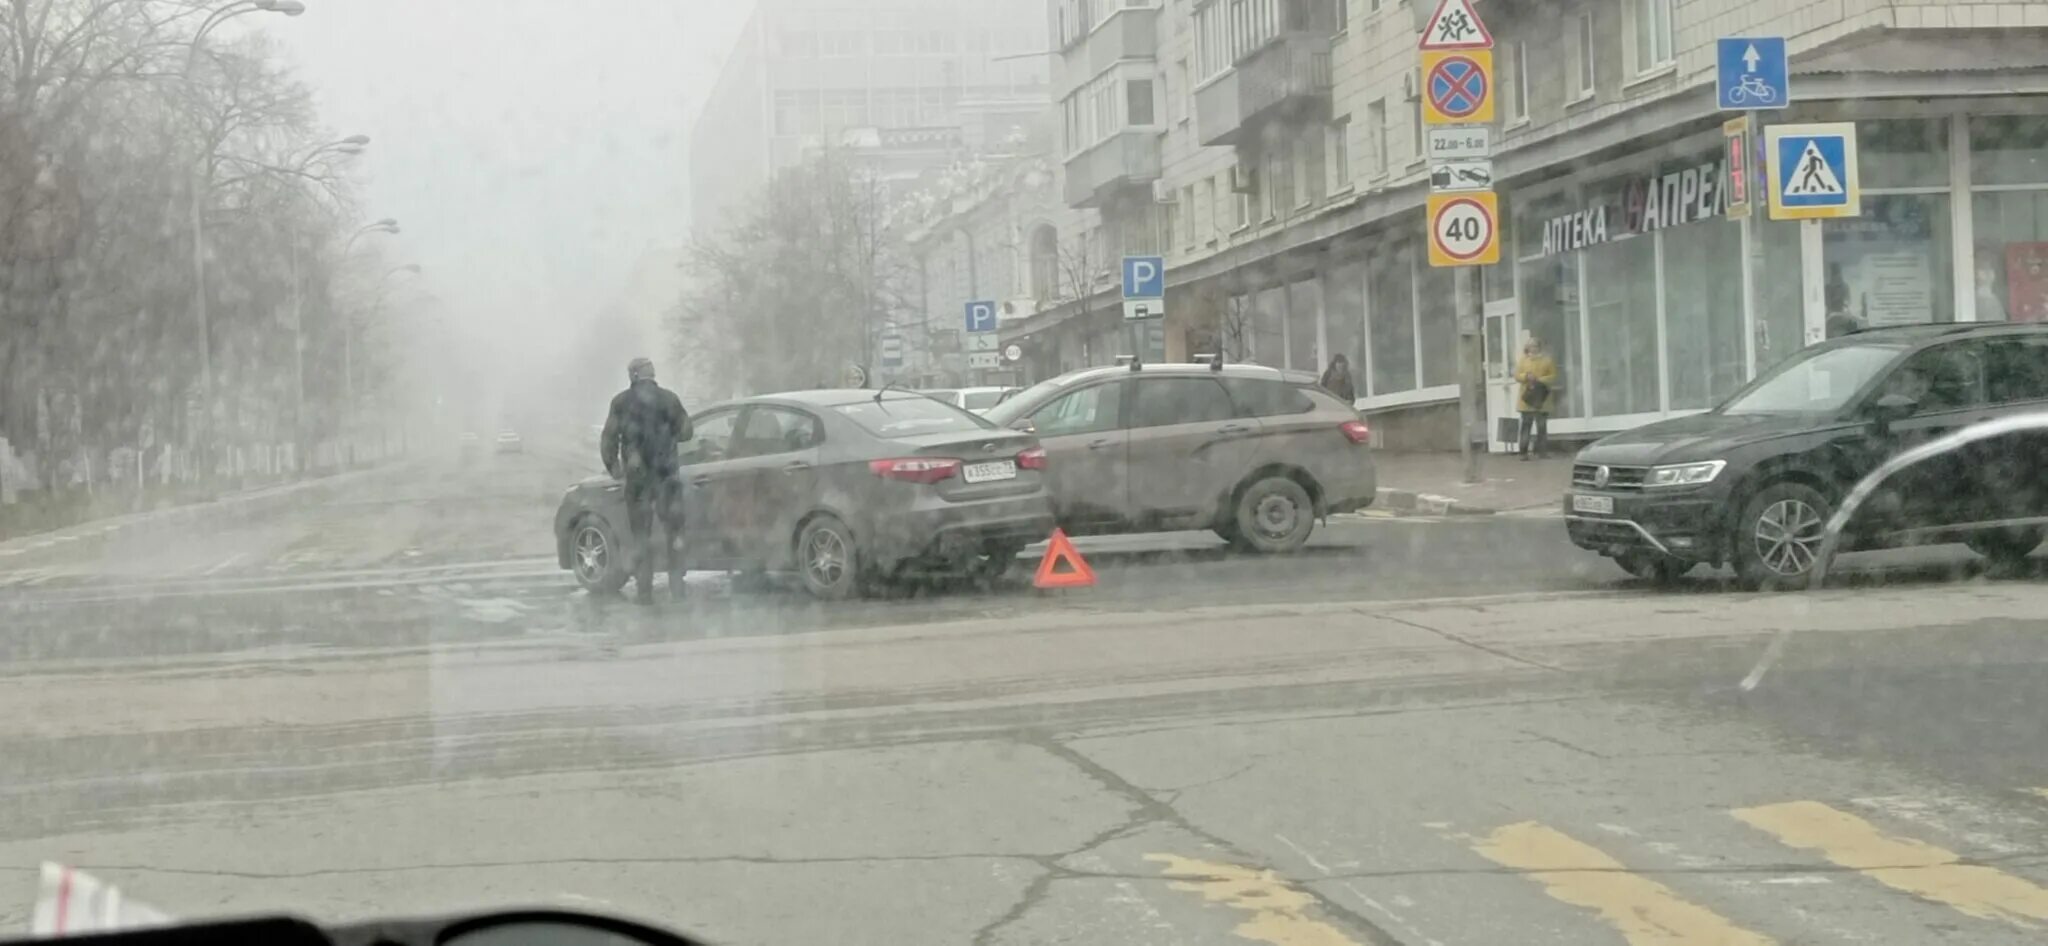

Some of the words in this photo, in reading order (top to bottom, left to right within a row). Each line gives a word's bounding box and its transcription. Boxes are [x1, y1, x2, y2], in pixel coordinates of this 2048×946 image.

[1542, 206, 1606, 256] АПТЕКА
[1642, 159, 1728, 232] АПРЕЛ
[1446, 217, 1479, 241] 40
[1133, 261, 1155, 294] P
[973, 305, 990, 329] P
